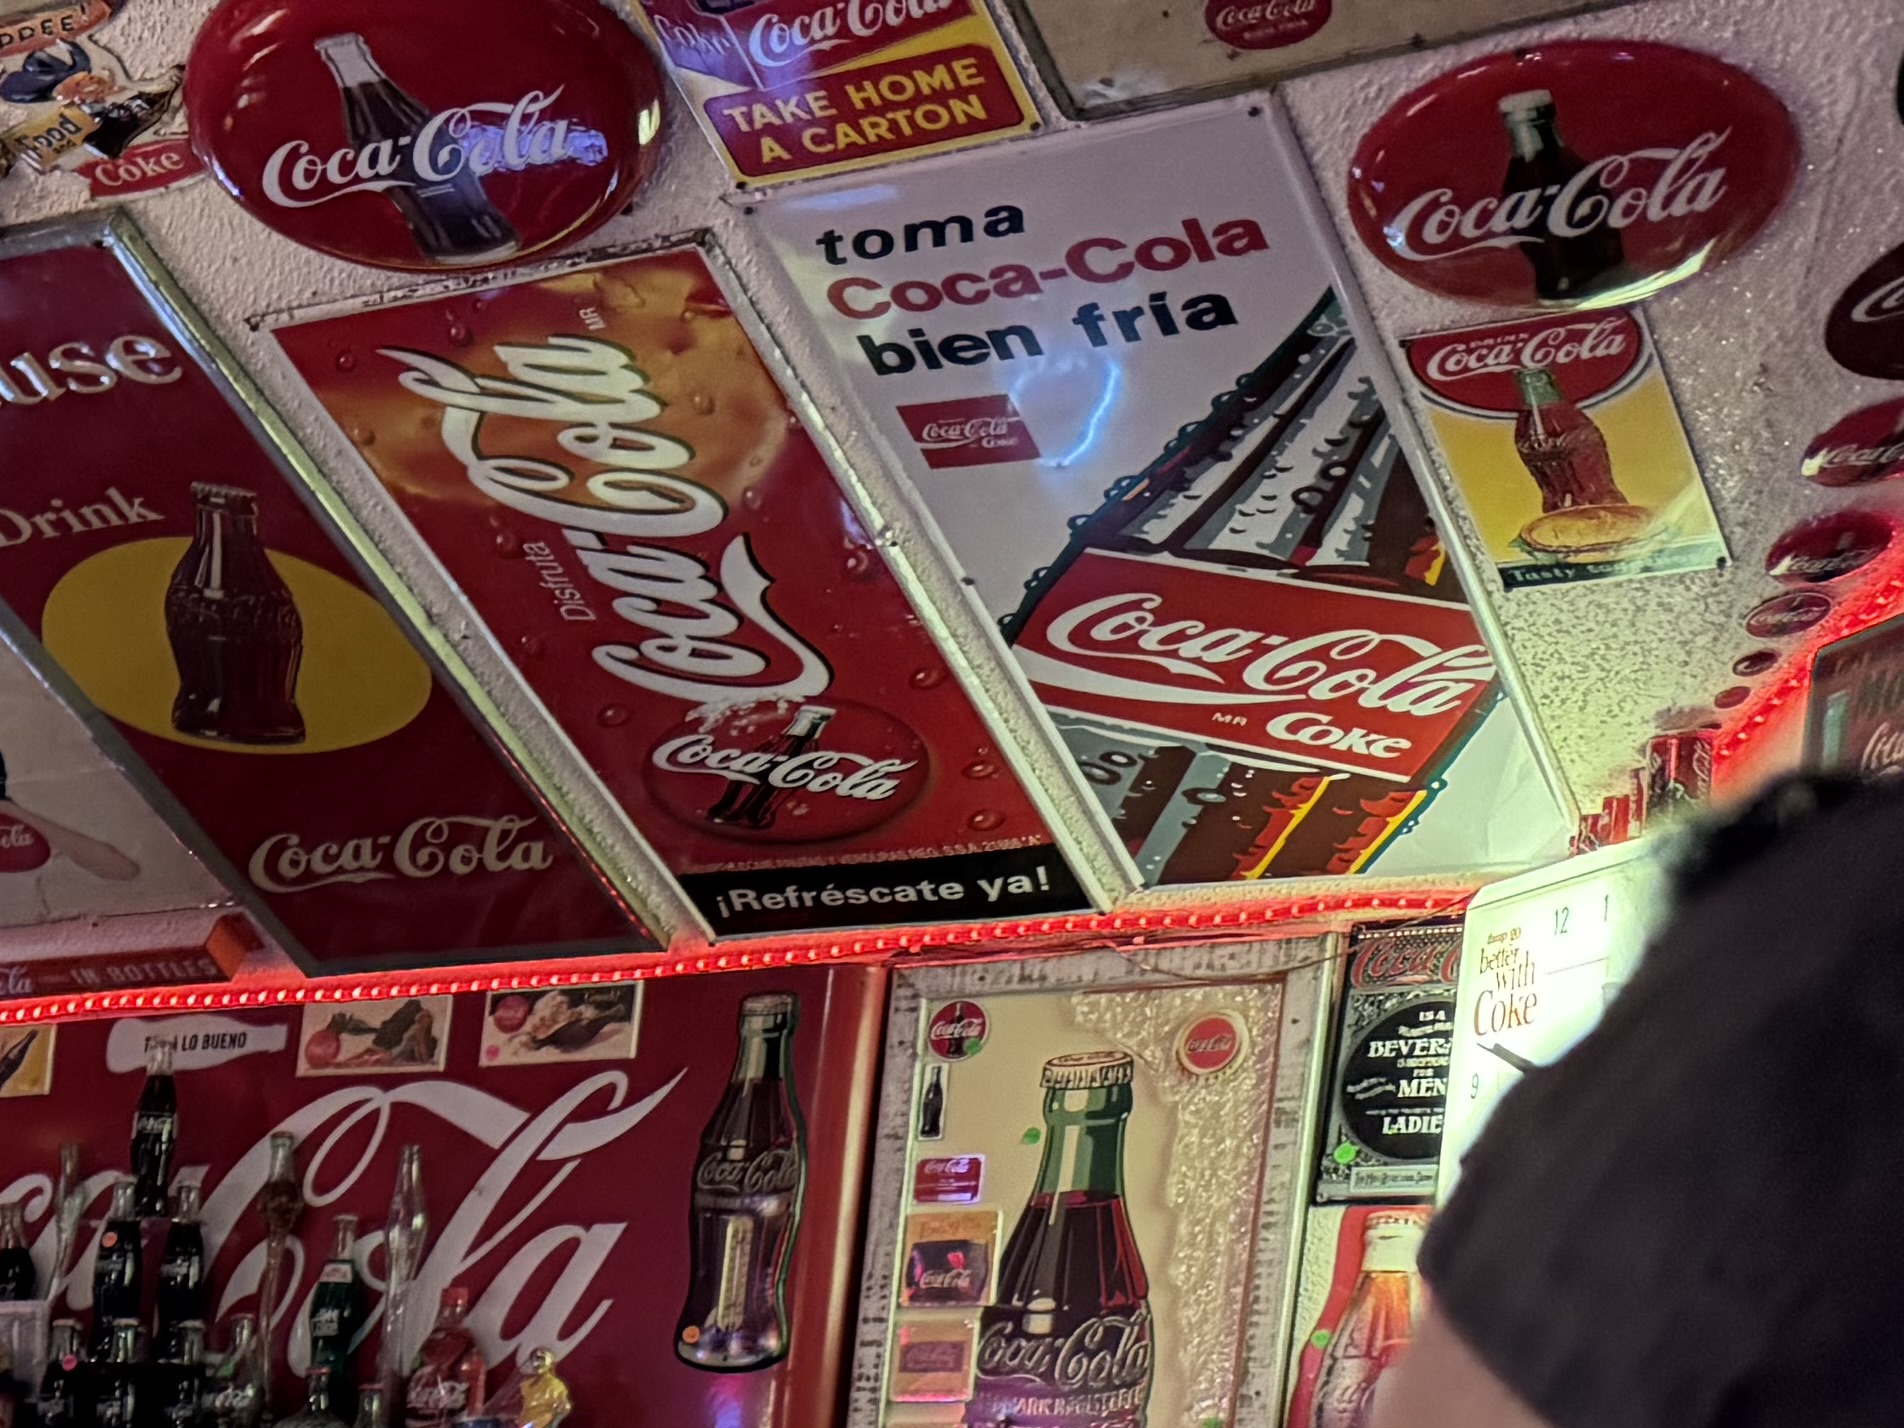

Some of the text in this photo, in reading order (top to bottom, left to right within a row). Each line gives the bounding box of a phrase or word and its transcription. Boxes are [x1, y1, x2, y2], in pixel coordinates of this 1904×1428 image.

[723, 58, 984, 133] TAKE HOME
[760, 95, 988, 164] A CARTON
[94, 150, 184, 187] Coke
[1392, 126, 1732, 263] Coca-Cola
[816, 206, 1024, 266] toma
[827, 216, 1270, 320] Coca-Cola
[857, 289, 1239, 377] bien fría
[521, 541, 592, 623] Disfruta
[717, 865, 1050, 918] ¡Refréscate ya!
[69, 964, 90, 985] IN
[98, 952, 214, 985] BOTTLES
[1479, 948, 1519, 974] better
[1496, 950, 1536, 992] with
[1473, 990, 1538, 1036] Coke
[183, 1032, 200, 1053] LO
[203, 1030, 247, 1052] BUENO
